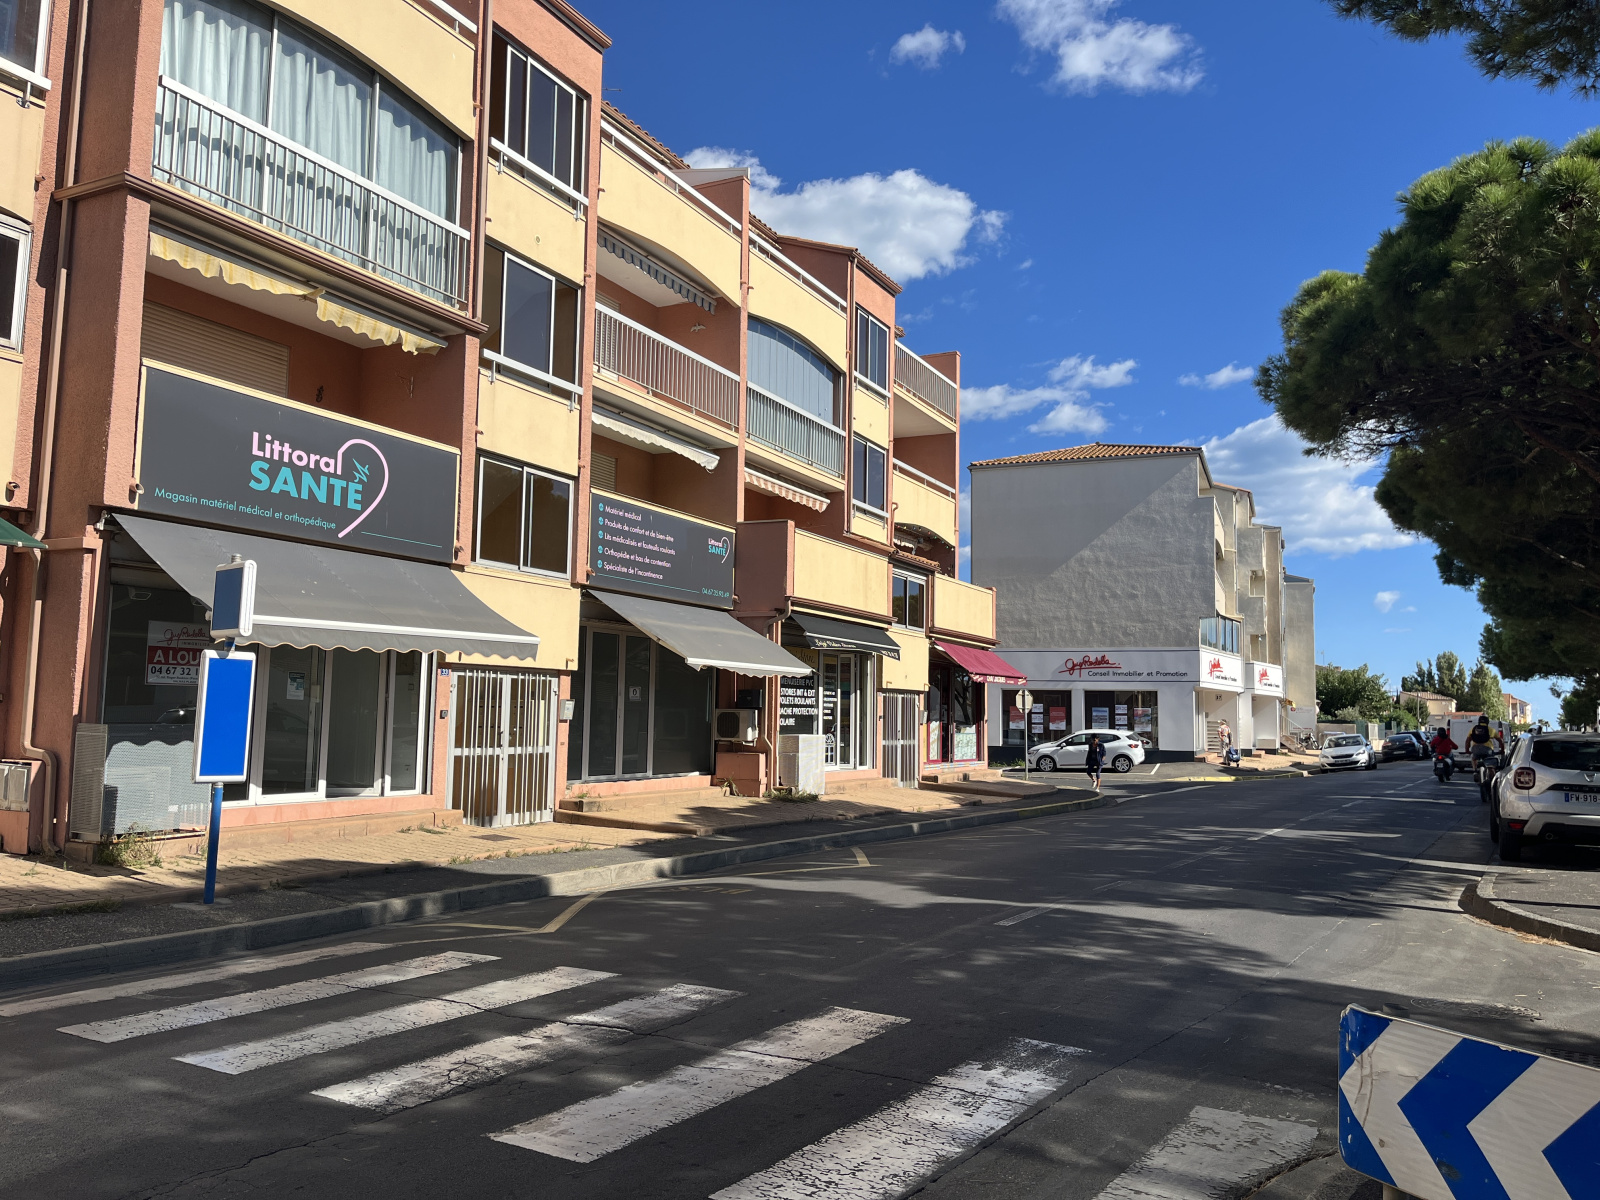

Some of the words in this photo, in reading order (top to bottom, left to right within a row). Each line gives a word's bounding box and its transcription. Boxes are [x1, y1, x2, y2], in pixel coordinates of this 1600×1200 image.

[251, 431, 343, 475] Littoral
[154, 487, 198, 504] Magasin
[200, 496, 237, 511] matériel
[238, 505, 273, 518] médical
[274, 511, 283, 520] et
[284, 512, 336, 530] orthopédique
[604, 505, 625, 517] Matériel
[624, 511, 642, 522] médical
[604, 518, 622, 530] Produits
[622, 523, 629, 532] de
[629, 526, 645, 536] confort
[649, 530, 656, 538] de
[656, 531, 674, 542] bien-être
[604, 532, 612, 541] Lits
[612, 535, 638, 547] médicalisés
[642, 541, 660, 552] fauteuils
[659, 547, 676, 555] roulants
[604, 547, 630, 559] Orthopédie
[635, 554, 643, 563] bas
[643, 556, 650, 564] de
[650, 559, 672, 568] contention
[603, 562, 628, 573] Spécialiste
[627, 566, 634, 575] de
[153, 649, 165, 664] A
[168, 650, 200, 665] LOU
[150, 665, 162, 675] 04
[165, 666, 178, 675] 67
[179, 667, 192, 676] 32
[780, 688, 796, 696] STORES
[794, 697, 816, 705] ROULANTS
[779, 707, 793, 715] ACHE
[792, 708, 819, 716] PROTECTION
[779, 718, 796, 726] OLAIRE
[1569, 793, 1600, 802] FW-918-
